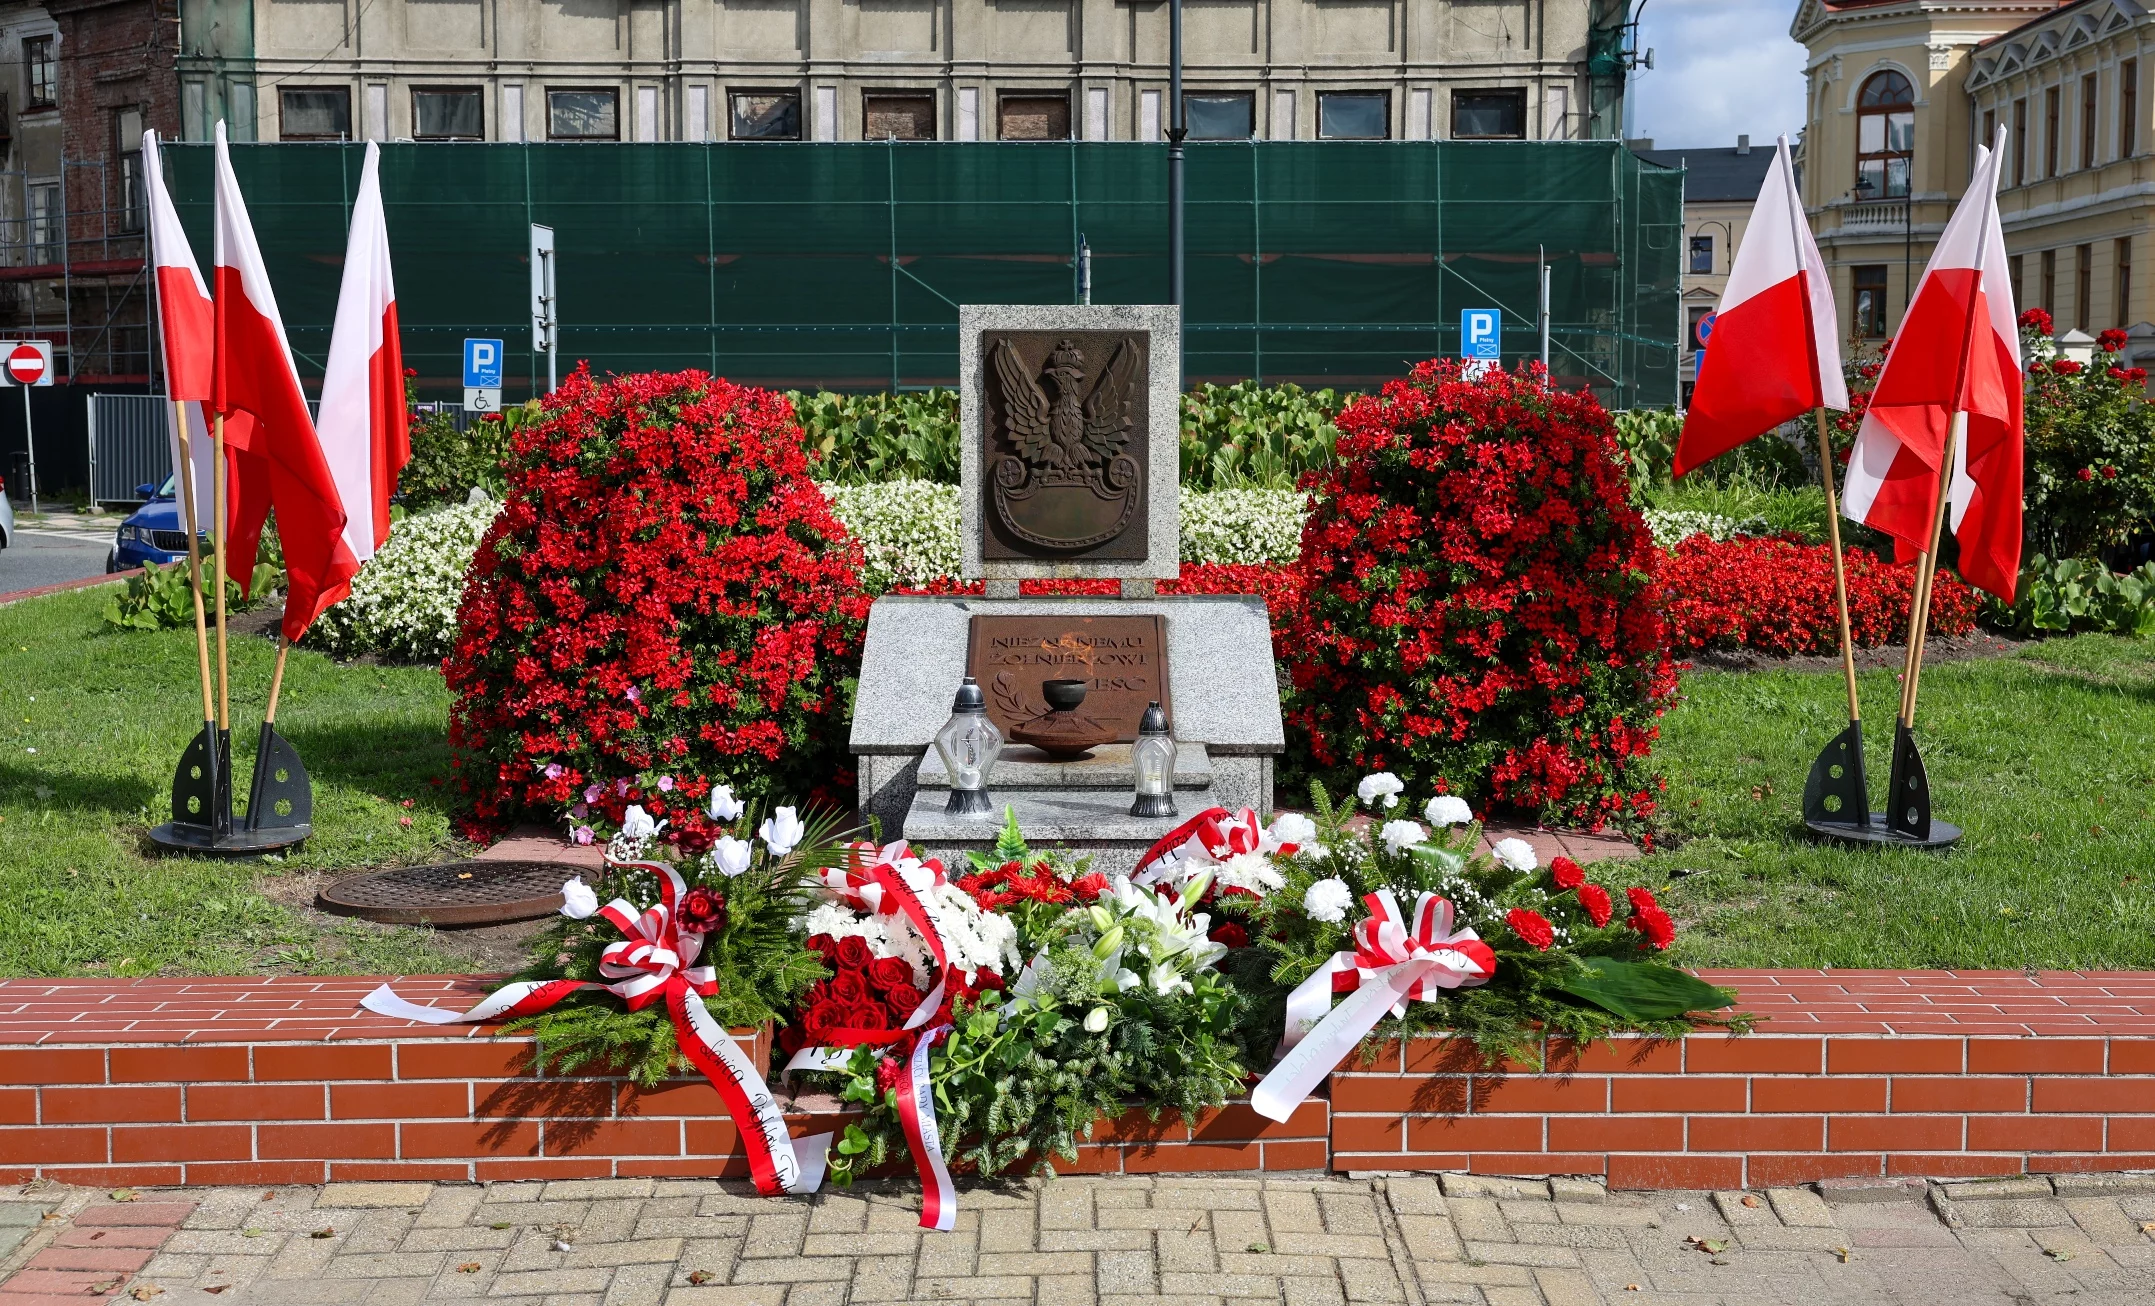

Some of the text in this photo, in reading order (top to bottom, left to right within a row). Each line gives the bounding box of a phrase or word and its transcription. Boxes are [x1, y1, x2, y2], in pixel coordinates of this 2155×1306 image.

[1470, 313, 1493, 344] P
[472, 343, 495, 373] P
[700, 1038, 744, 1087] Lewica
[920, 1114, 935, 1152] MIASTA
